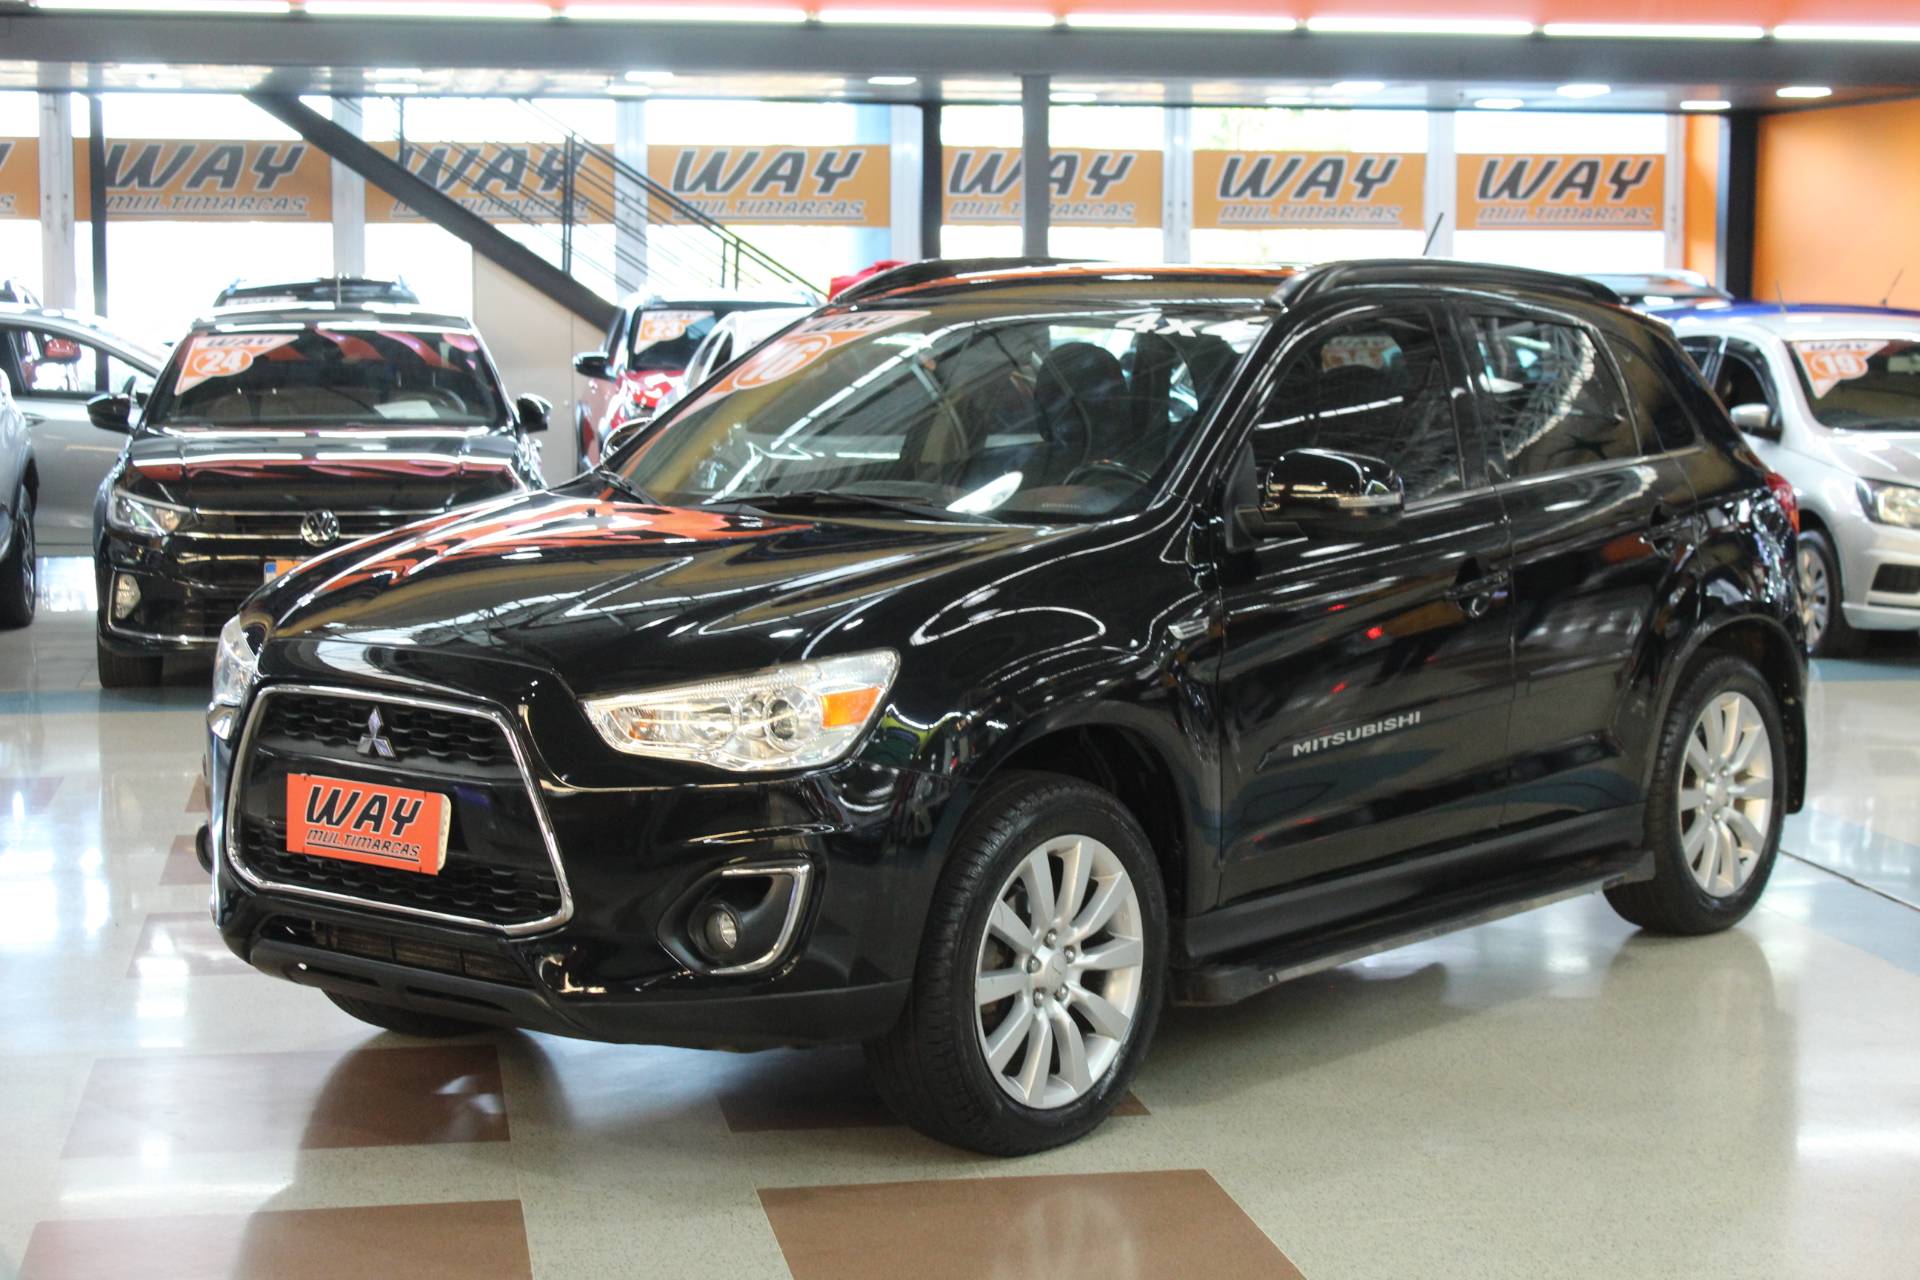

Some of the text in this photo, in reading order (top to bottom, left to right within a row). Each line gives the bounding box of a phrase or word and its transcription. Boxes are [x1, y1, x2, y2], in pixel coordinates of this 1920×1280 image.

[104, 143, 307, 191] WAY
[672, 149, 865, 195] WAY
[949, 151, 1136, 197] WAY
[1217, 156, 1401, 200] WAY
[1476, 159, 1655, 201] WAY
[951, 201, 1136, 216] MULTARCAS
[1220, 204, 1400, 220] MULTIMARCAS
[202, 350, 244, 373] 24
[1822, 354, 1857, 376] 19
[1292, 711, 1422, 757] MITSUBISHI
[305, 785, 423, 837] WAY
[306, 829, 422, 857] MULTIMARCAS
